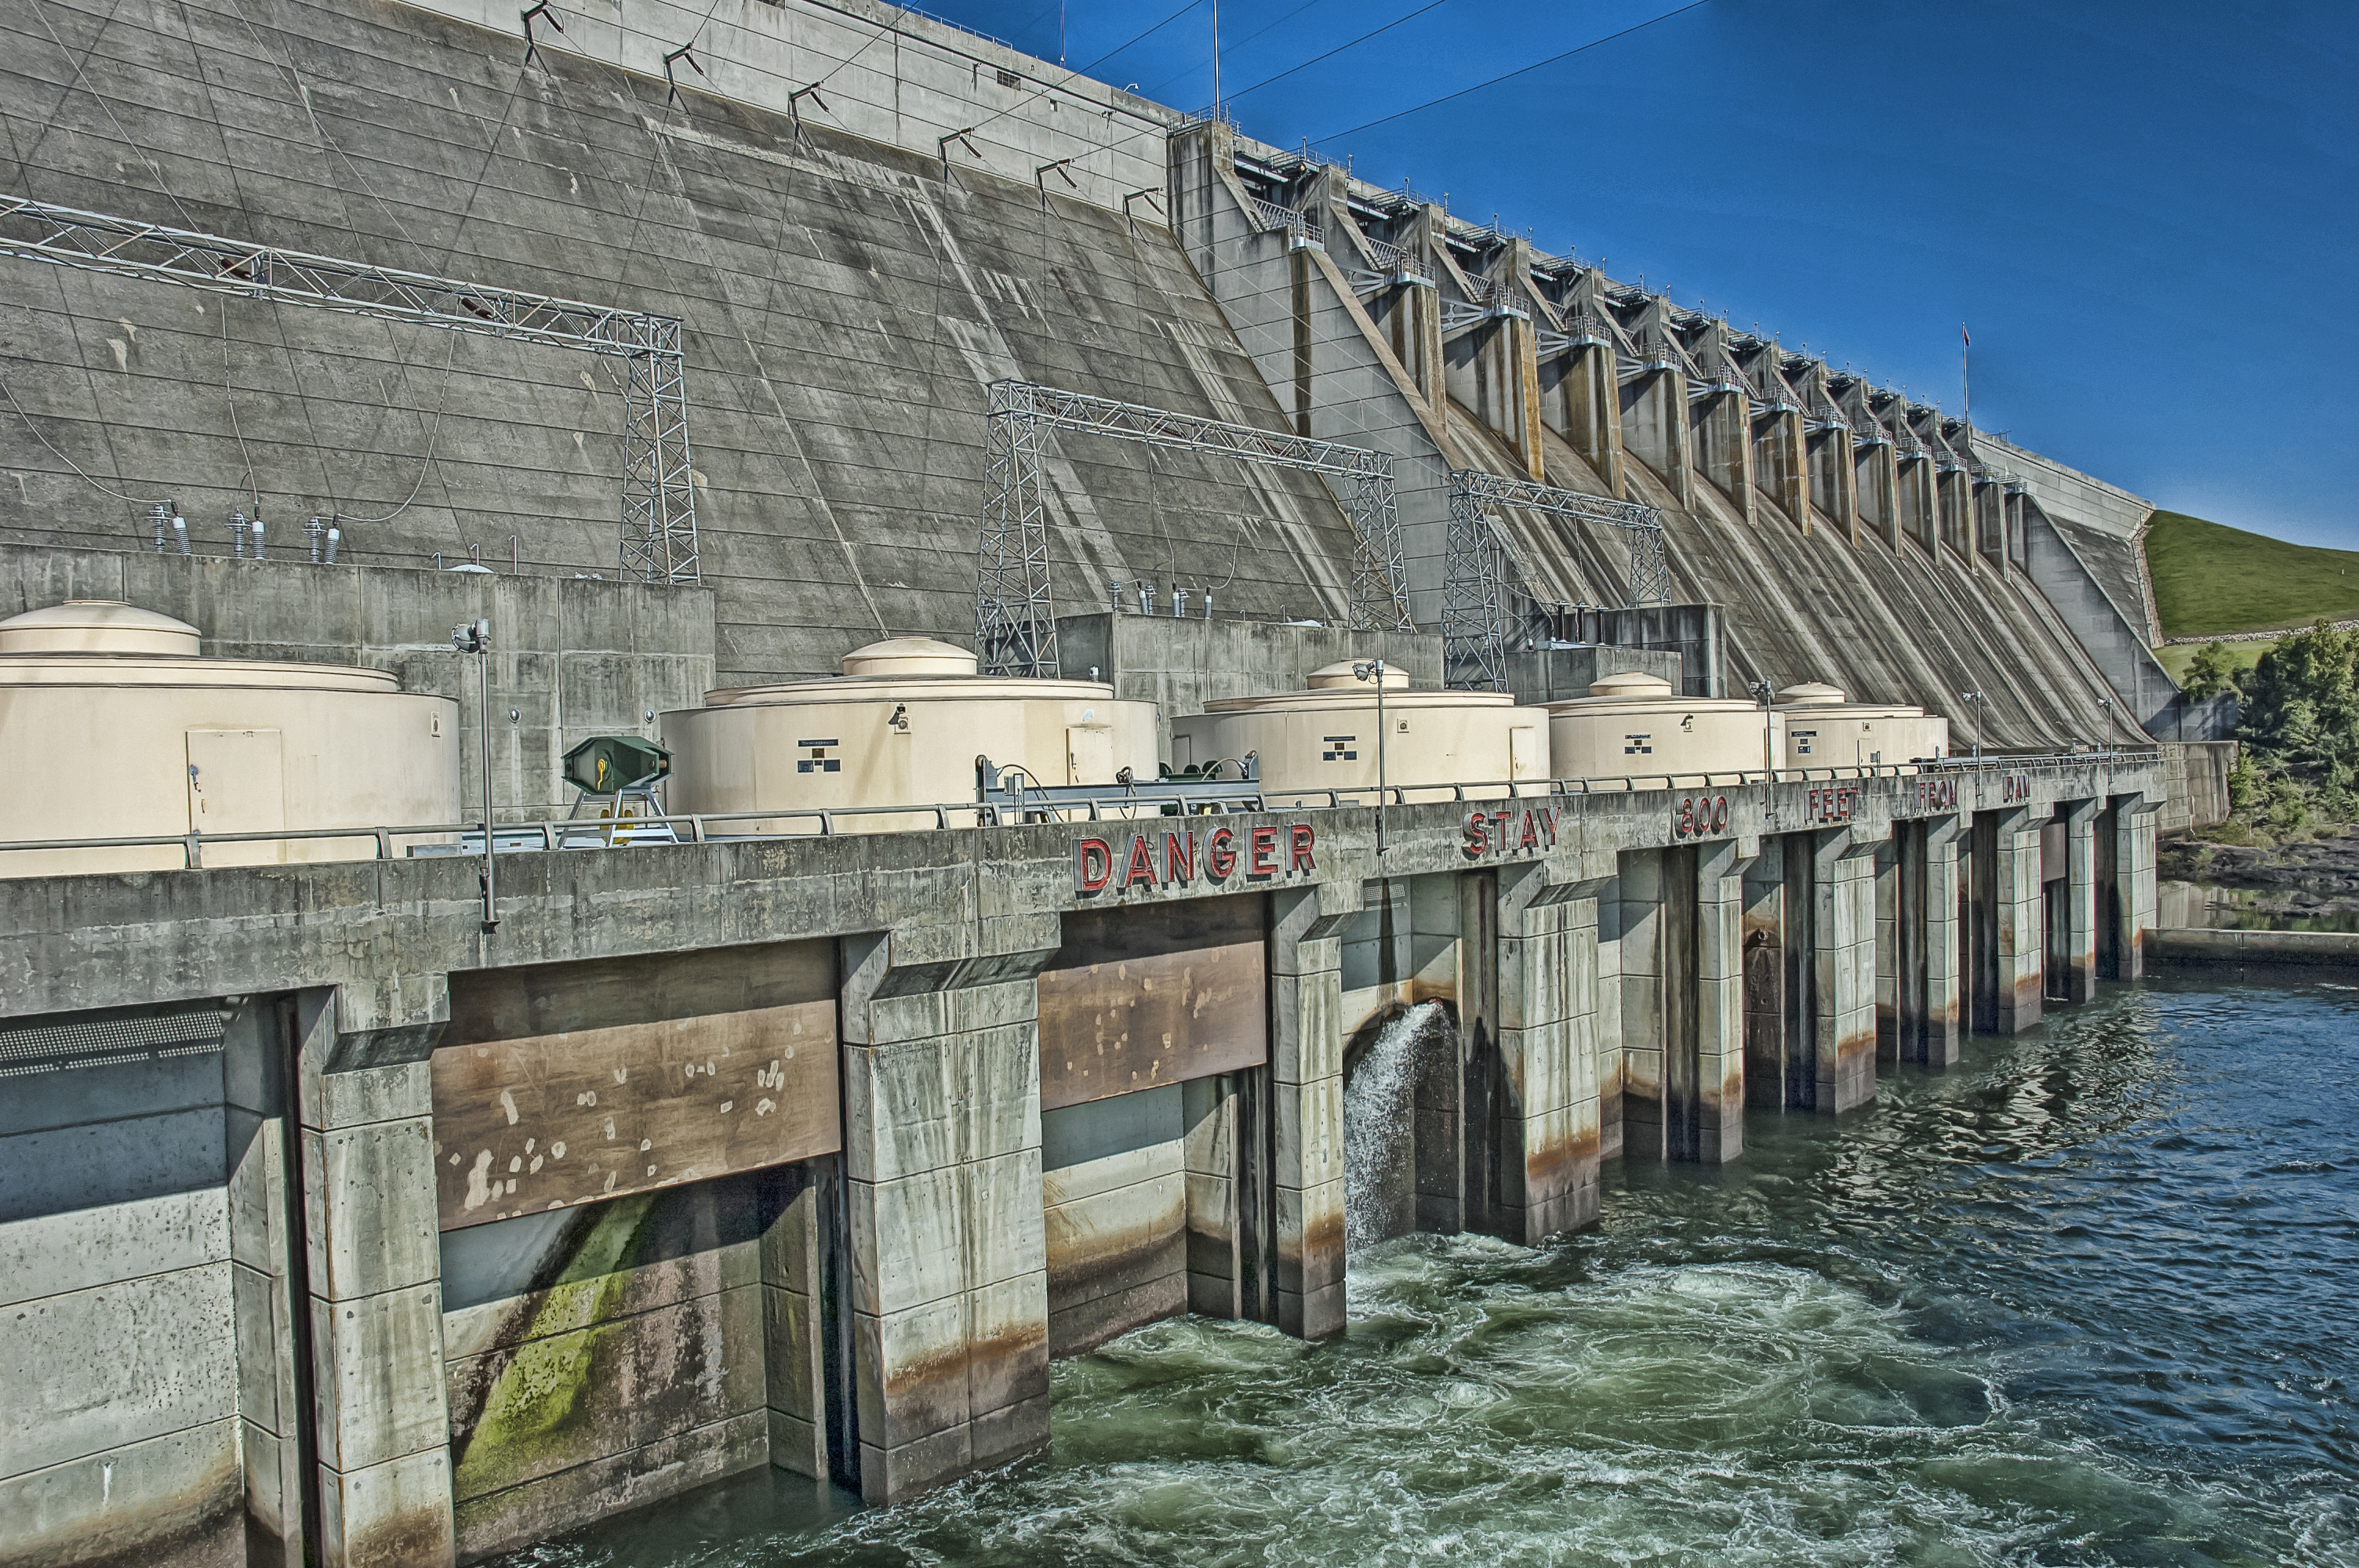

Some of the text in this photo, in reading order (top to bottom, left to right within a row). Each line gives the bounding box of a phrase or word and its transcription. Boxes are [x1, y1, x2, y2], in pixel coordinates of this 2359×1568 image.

[1071, 775, 2030, 891] DANGER STAY 800 FEET FROM DAM
